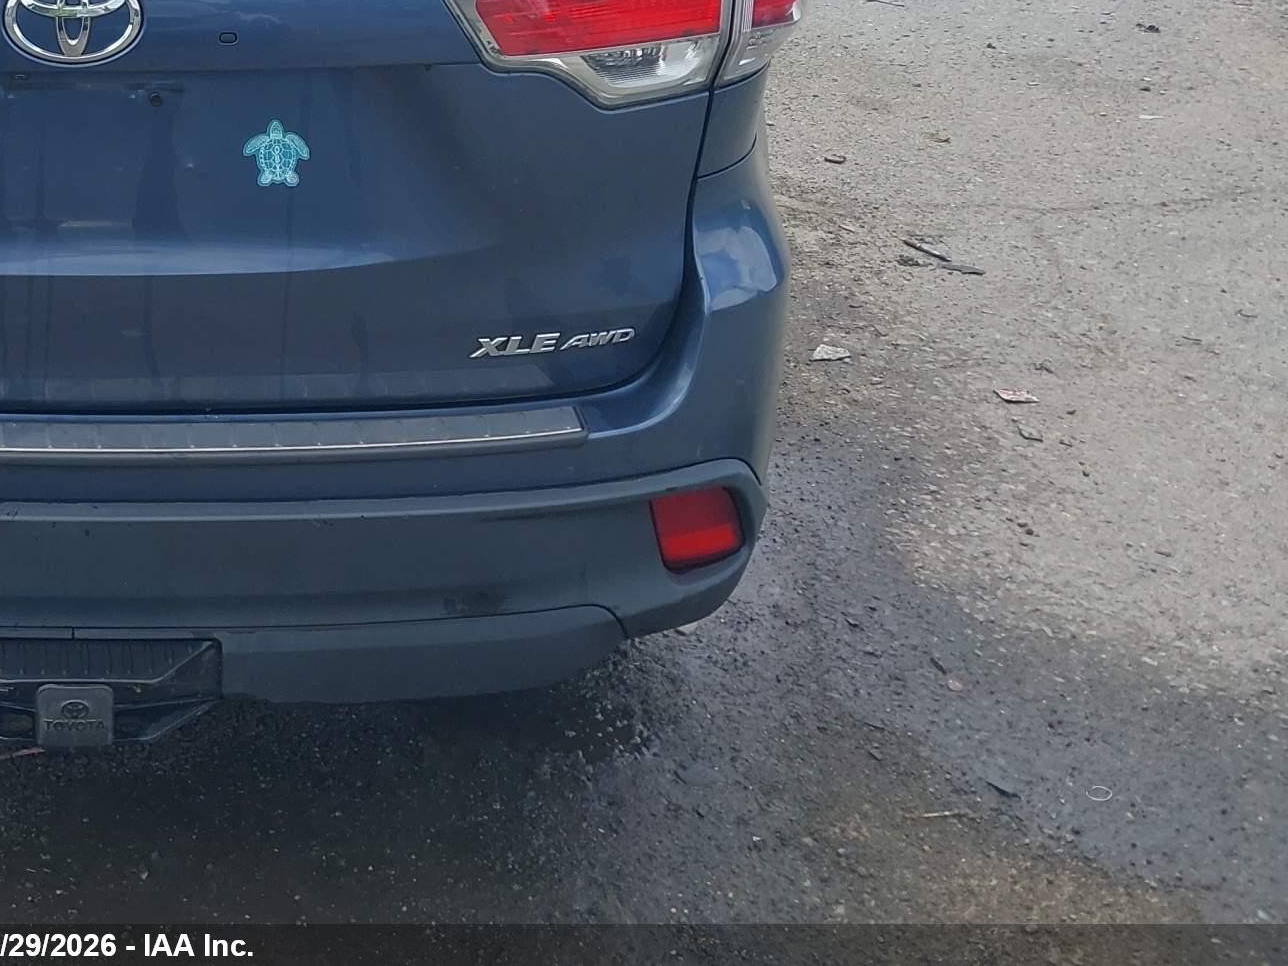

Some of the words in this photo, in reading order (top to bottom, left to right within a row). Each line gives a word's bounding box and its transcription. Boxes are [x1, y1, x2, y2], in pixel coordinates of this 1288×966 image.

[469, 333, 560, 358] XLE
[560, 328, 635, 350] AWD
[43, 718, 105, 732] TOYOTA
